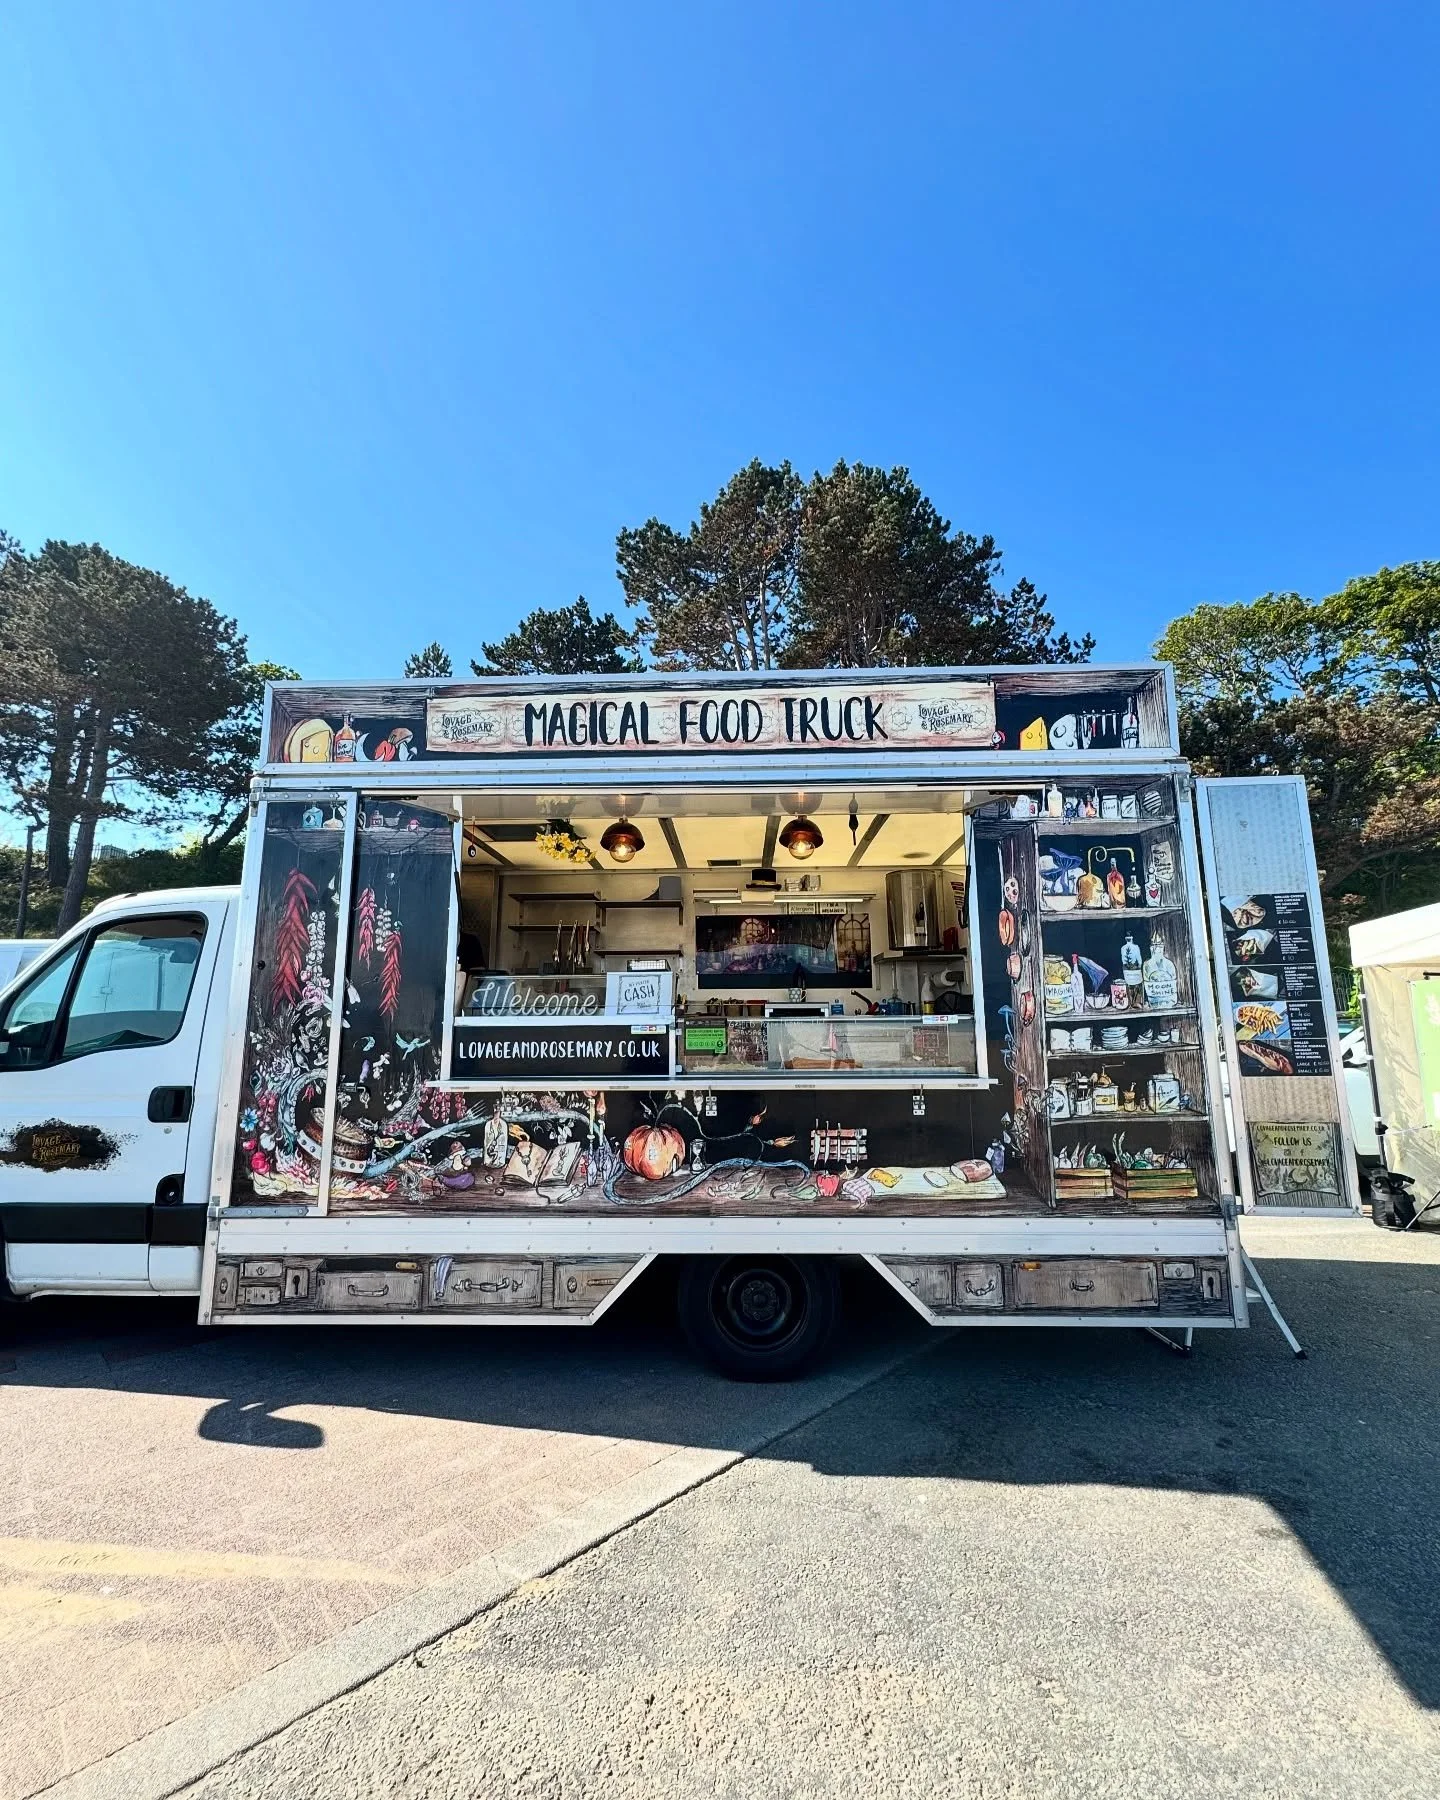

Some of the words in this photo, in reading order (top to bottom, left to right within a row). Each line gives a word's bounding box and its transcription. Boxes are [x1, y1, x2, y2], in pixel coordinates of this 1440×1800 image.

[442, 714, 472, 728] LOVAGE
[525, 701, 659, 746] MAGICAL
[680, 699, 762, 744] FOOD
[780, 696, 888, 742] TRUCK
[918, 704, 950, 719] LOVAGE
[444, 729, 450, 738] &
[450, 722, 494, 741] ROSEMARY
[921, 720, 928, 730] &
[928, 713, 973, 732] ROSEMARY
[472, 981, 598, 1017] Welcome
[624, 984, 655, 1002] CASH
[459, 1040, 661, 1059] LOVAGEANDROSEMARY.CO.UK
[1273, 1137, 1300, 1146] FOLLOW
[1302, 1138, 1313, 1146] US
